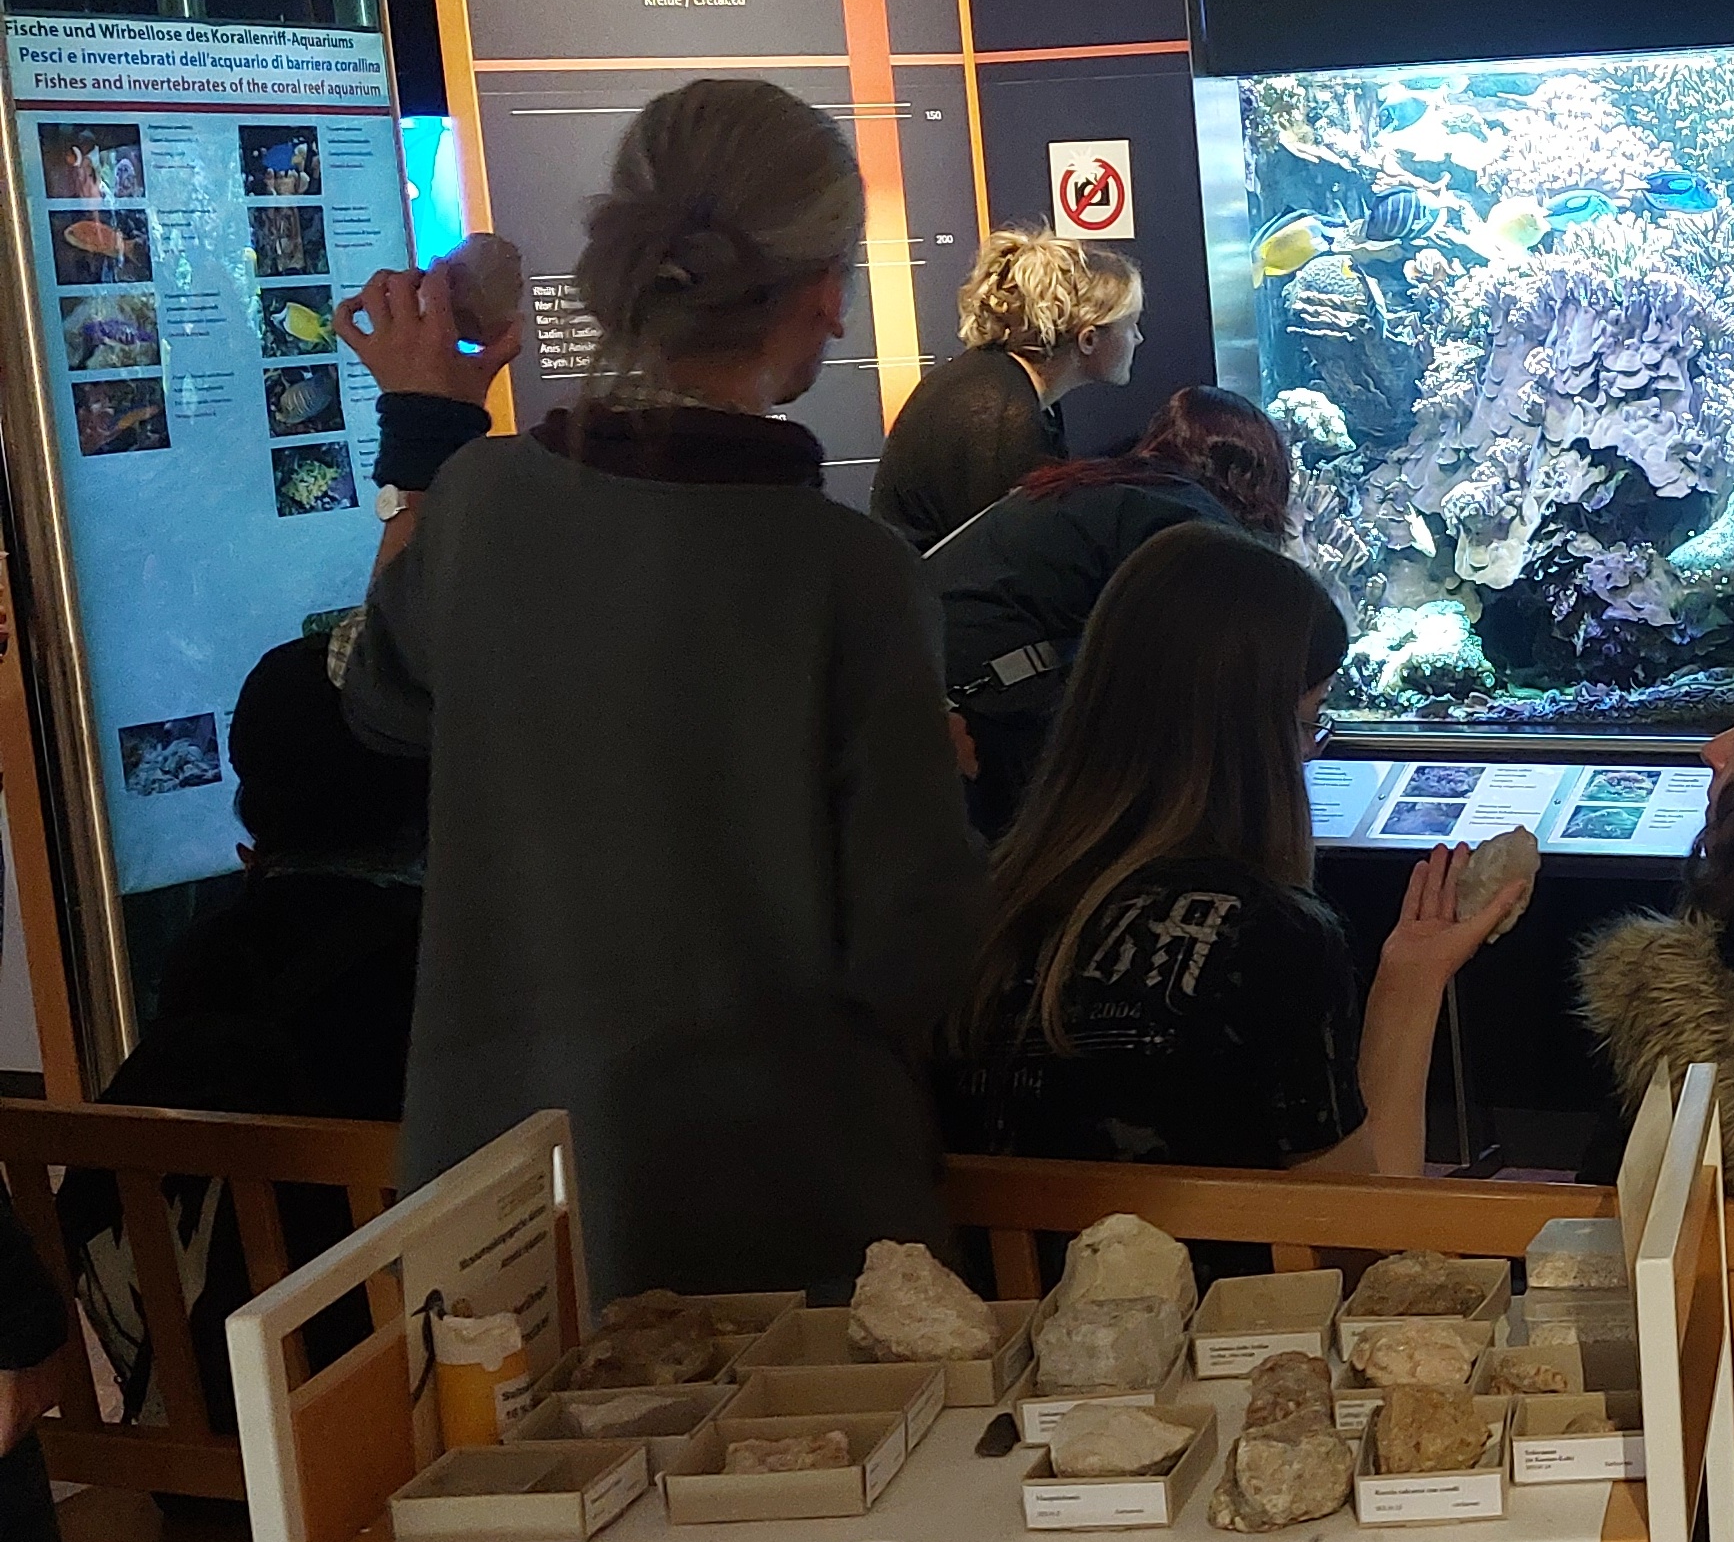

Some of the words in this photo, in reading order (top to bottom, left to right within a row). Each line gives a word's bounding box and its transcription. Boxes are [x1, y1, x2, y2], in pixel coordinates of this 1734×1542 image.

[5, 20, 59, 38] Fische
[63, 22, 96, 39] und
[99, 23, 182, 42] Wirbellose
[186, 26, 208, 43] des
[211, 28, 355, 51] Korallenriff-Aquariums
[19, 46, 62, 63] Pesci
[67, 51, 78, 64] e
[82, 47, 176, 67] invertebrati
[180, 51, 268, 72] dell'acquario
[272, 54, 284, 70] di
[287, 55, 332, 72] barriera
[335, 58, 381, 74] corallina
[34, 72, 87, 90] Fishes
[91, 74, 124, 91] and
[128, 75, 227, 93] invertebrates
[230, 77, 244, 93] of
[247, 77, 268, 94] the
[271, 78, 300, 95] coral
[303, 79, 325, 95] reef
[328, 81, 381, 99] aquarium
[925, 110, 942, 121] 150
[936, 234, 953, 245] 200
